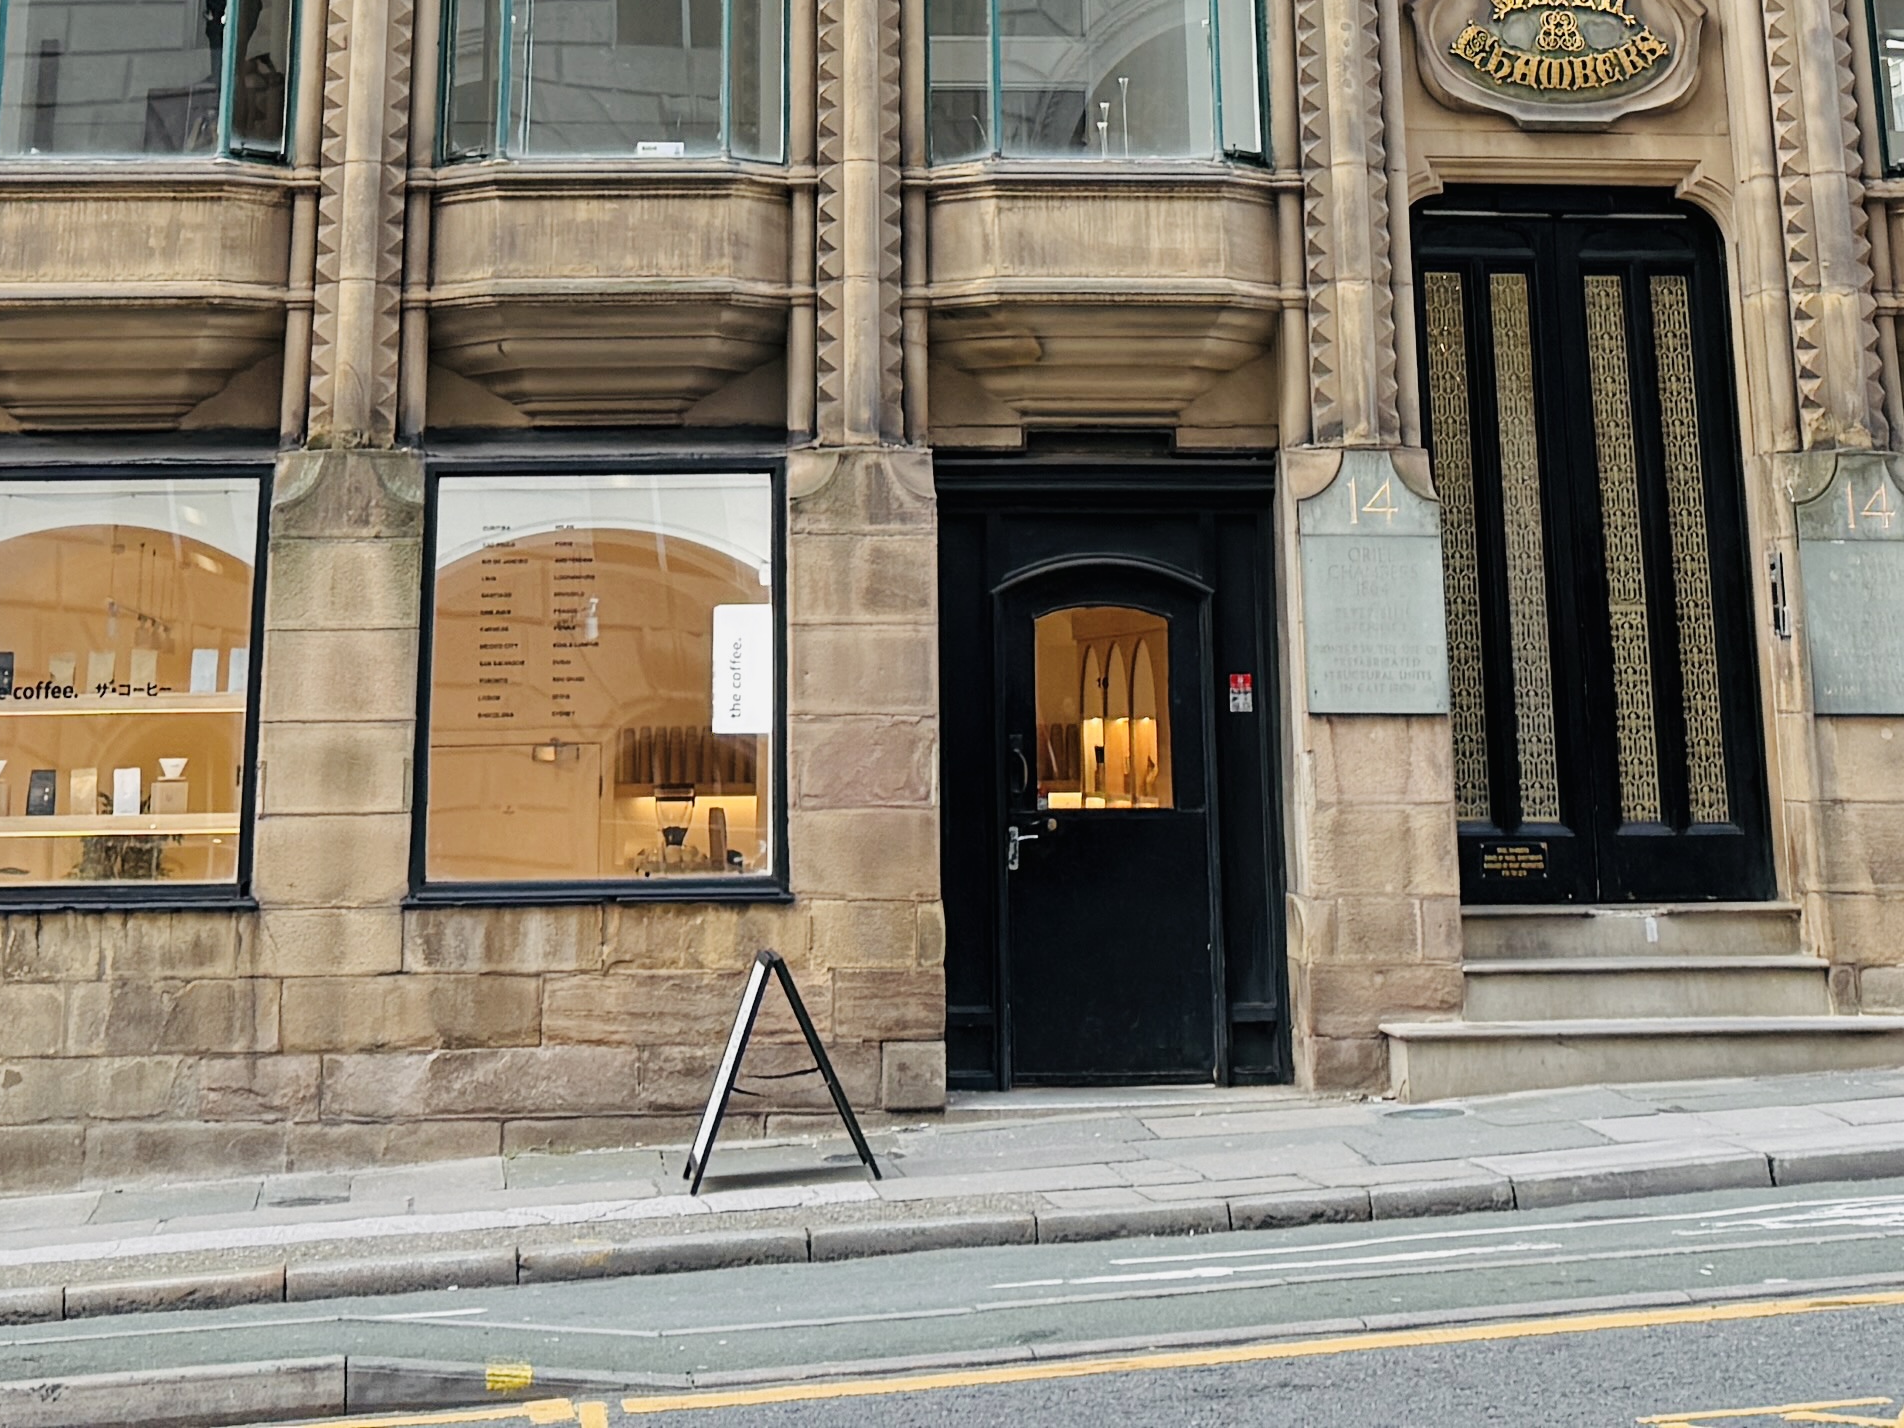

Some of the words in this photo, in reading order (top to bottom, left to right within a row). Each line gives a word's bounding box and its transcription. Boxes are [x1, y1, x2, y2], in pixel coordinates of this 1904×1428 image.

[1347, 476, 1399, 525] 14
[1848, 481, 1895, 529] 14
[729, 637, 743, 689] coffee.
[12, 681, 79, 700] coffee.
[729, 693, 742, 719] the
